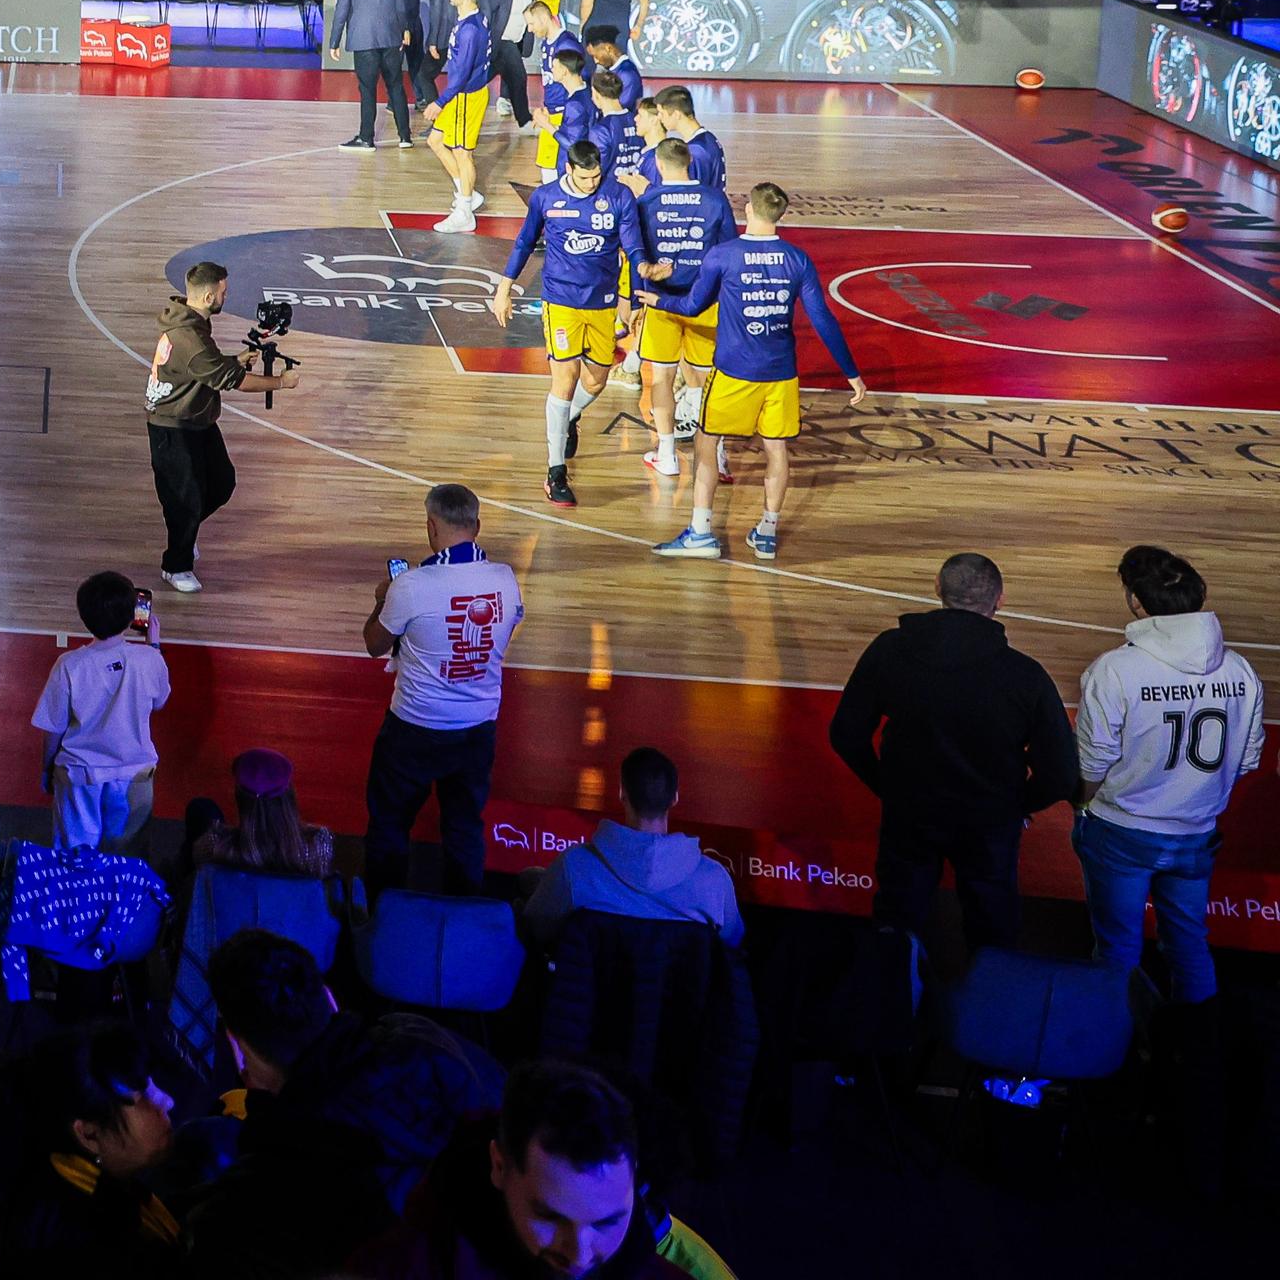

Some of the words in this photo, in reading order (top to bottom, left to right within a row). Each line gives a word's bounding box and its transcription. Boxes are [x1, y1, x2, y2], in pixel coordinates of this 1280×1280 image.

[1181, 0, 1199, 11] C2
[591, 213, 615, 230] 98
[262, 286, 403, 311] Bank
[1140, 683, 1204, 703] BEVERLY
[1210, 680, 1248, 700] HILLS
[1161, 708, 1228, 773] 10
[748, 857, 801, 882] Bank
[808, 860, 872, 890] Pekao
